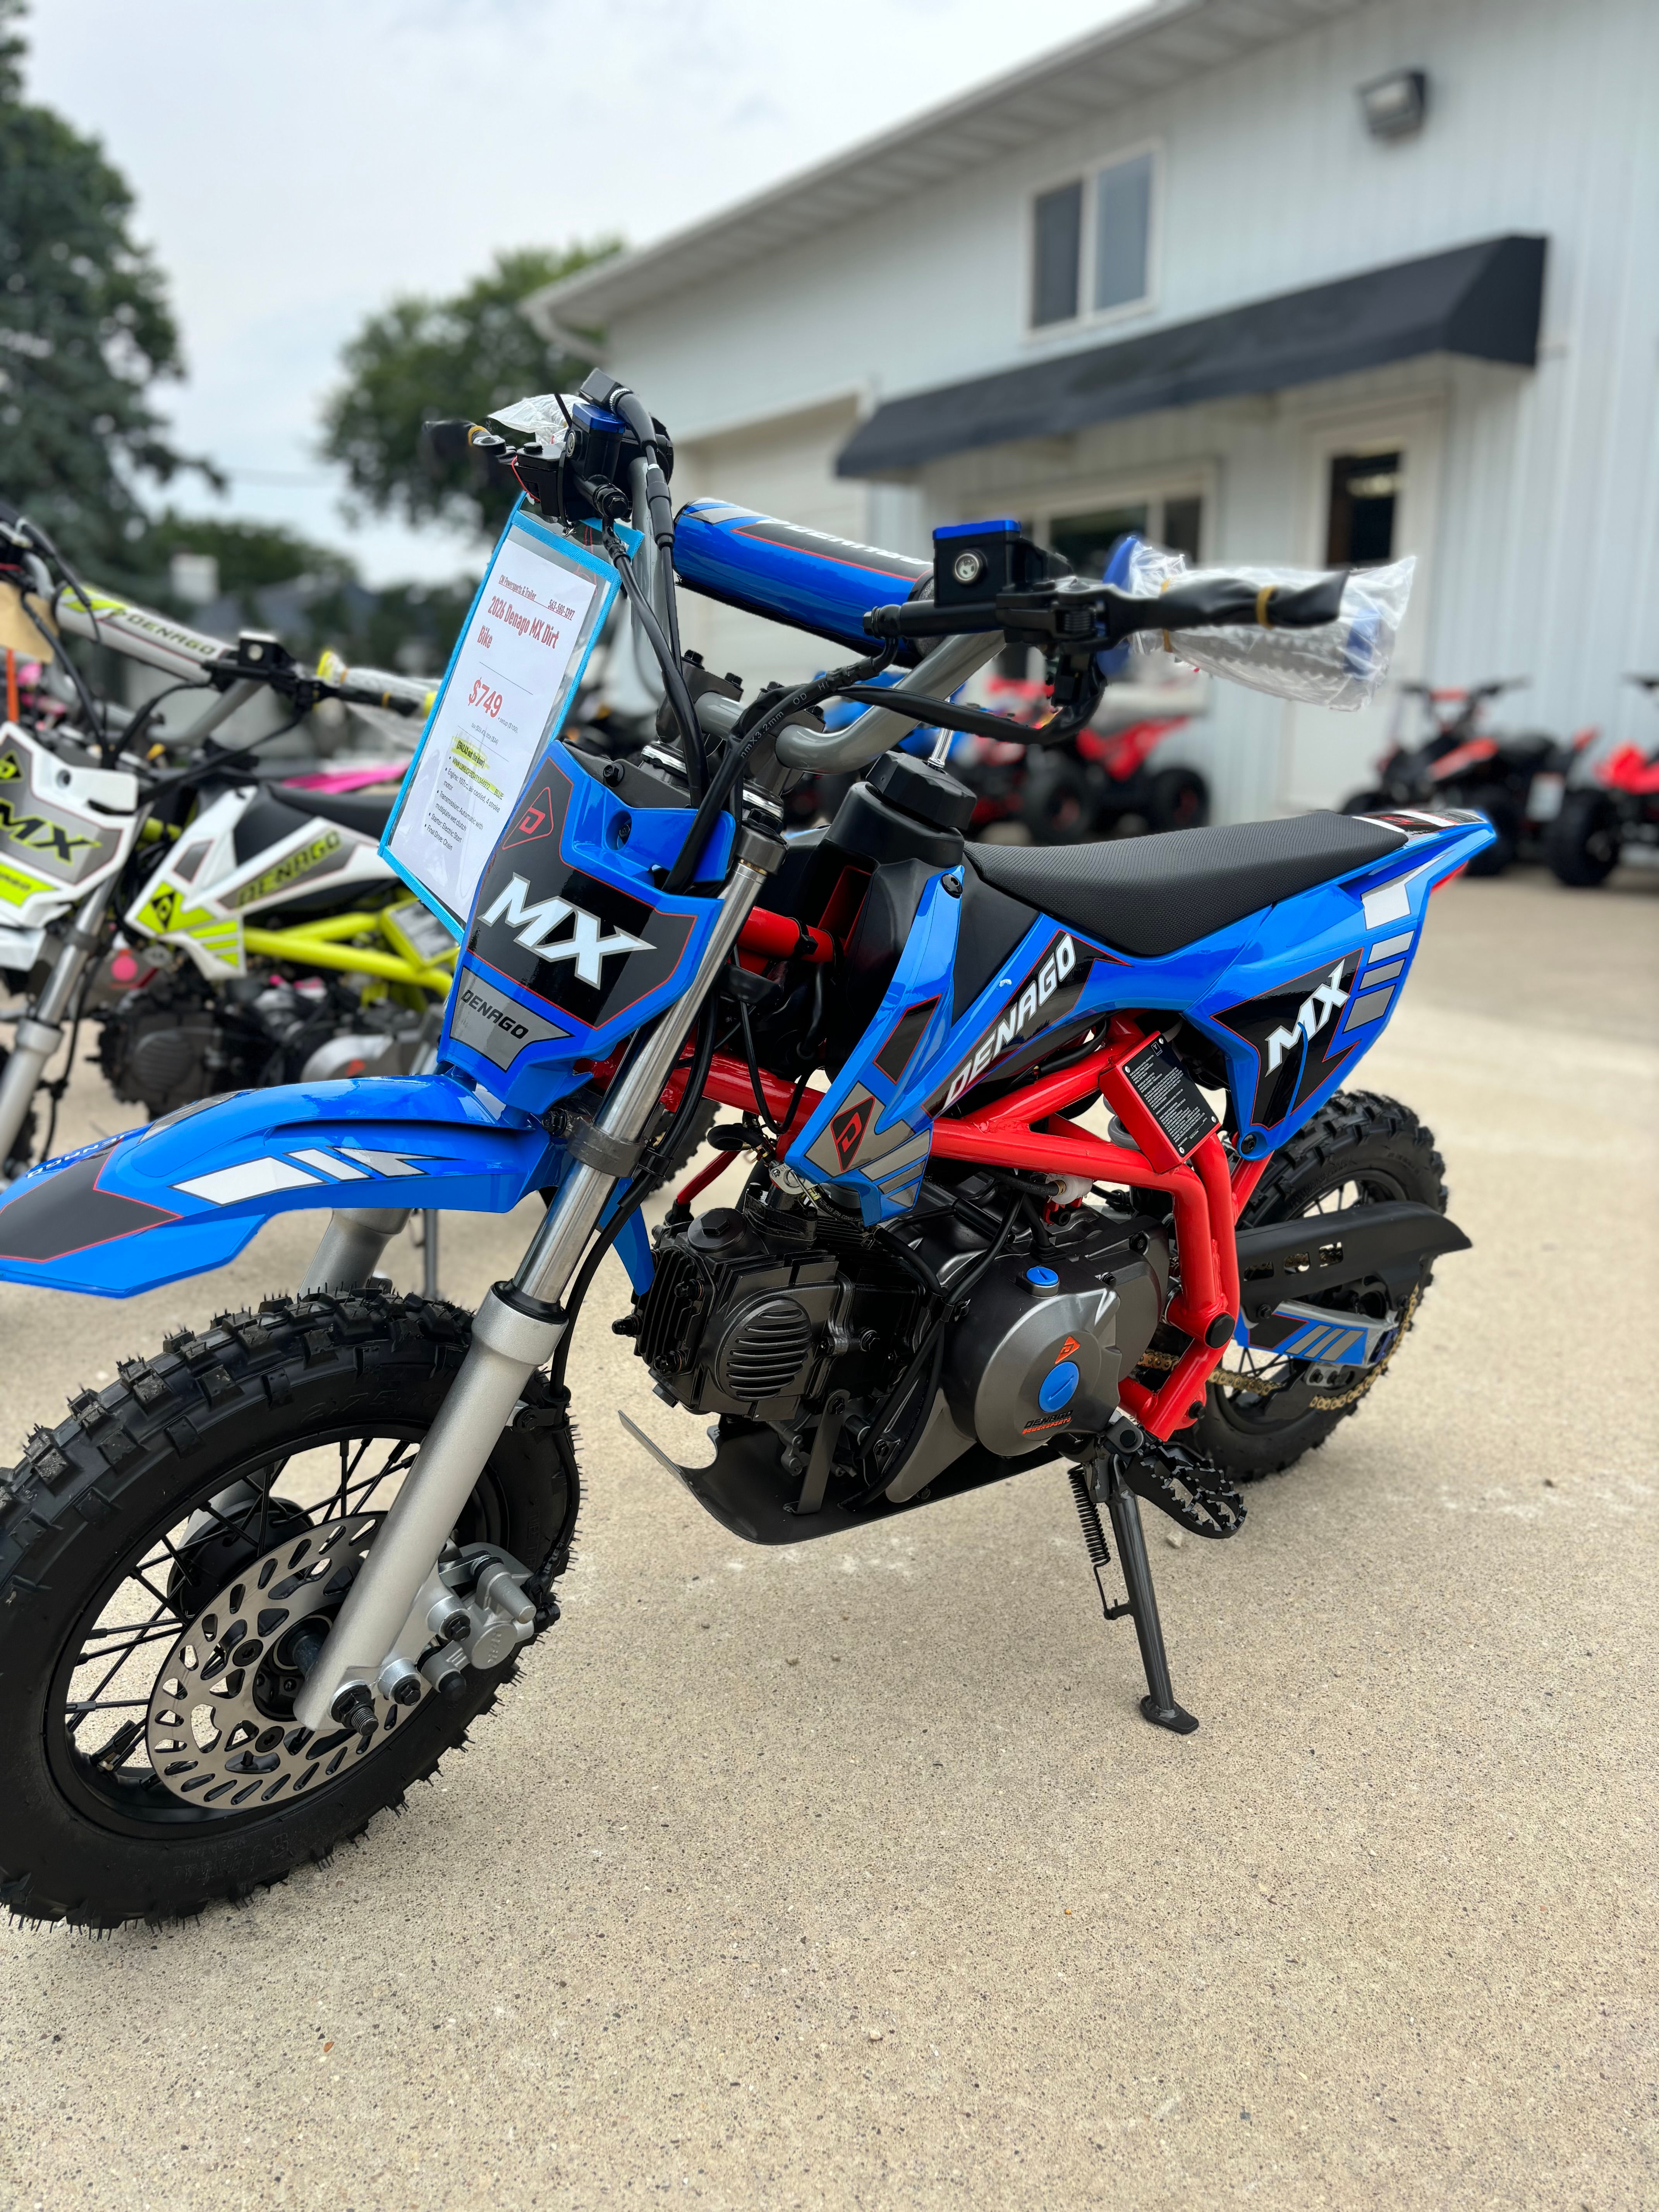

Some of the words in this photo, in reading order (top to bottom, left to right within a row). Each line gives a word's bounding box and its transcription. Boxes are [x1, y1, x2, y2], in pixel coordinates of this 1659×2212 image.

[128, 613, 216, 655] DENAGO
[488, 596, 507, 620] 2026
[504, 604, 531, 636] Denago
[529, 617, 545, 641] MX
[541, 623, 560, 649] Dirt
[477, 625, 493, 649] Bike
[468, 677, 502, 718] $749
[793, 692, 807, 706] OD
[443, 781, 453, 791] motor
[494, 788, 504, 800] BLUE
[459, 807, 476, 824] Automatic
[489, 801, 500, 813] stroke
[0, 798, 102, 866] MX
[442, 823, 454, 837] Electric
[453, 832, 462, 843] Start
[443, 838, 453, 851] Chain
[236, 830, 342, 909] DENAGO
[477, 872, 658, 990] MX
[461, 990, 529, 1040] DENAGO
[943, 933, 1075, 1109] DENAGO
[1265, 959, 1351, 1077] MX
[1022, 1417, 1072, 1435] POWERSPORTS
[1024, 1410, 1073, 1428] DENAGO
